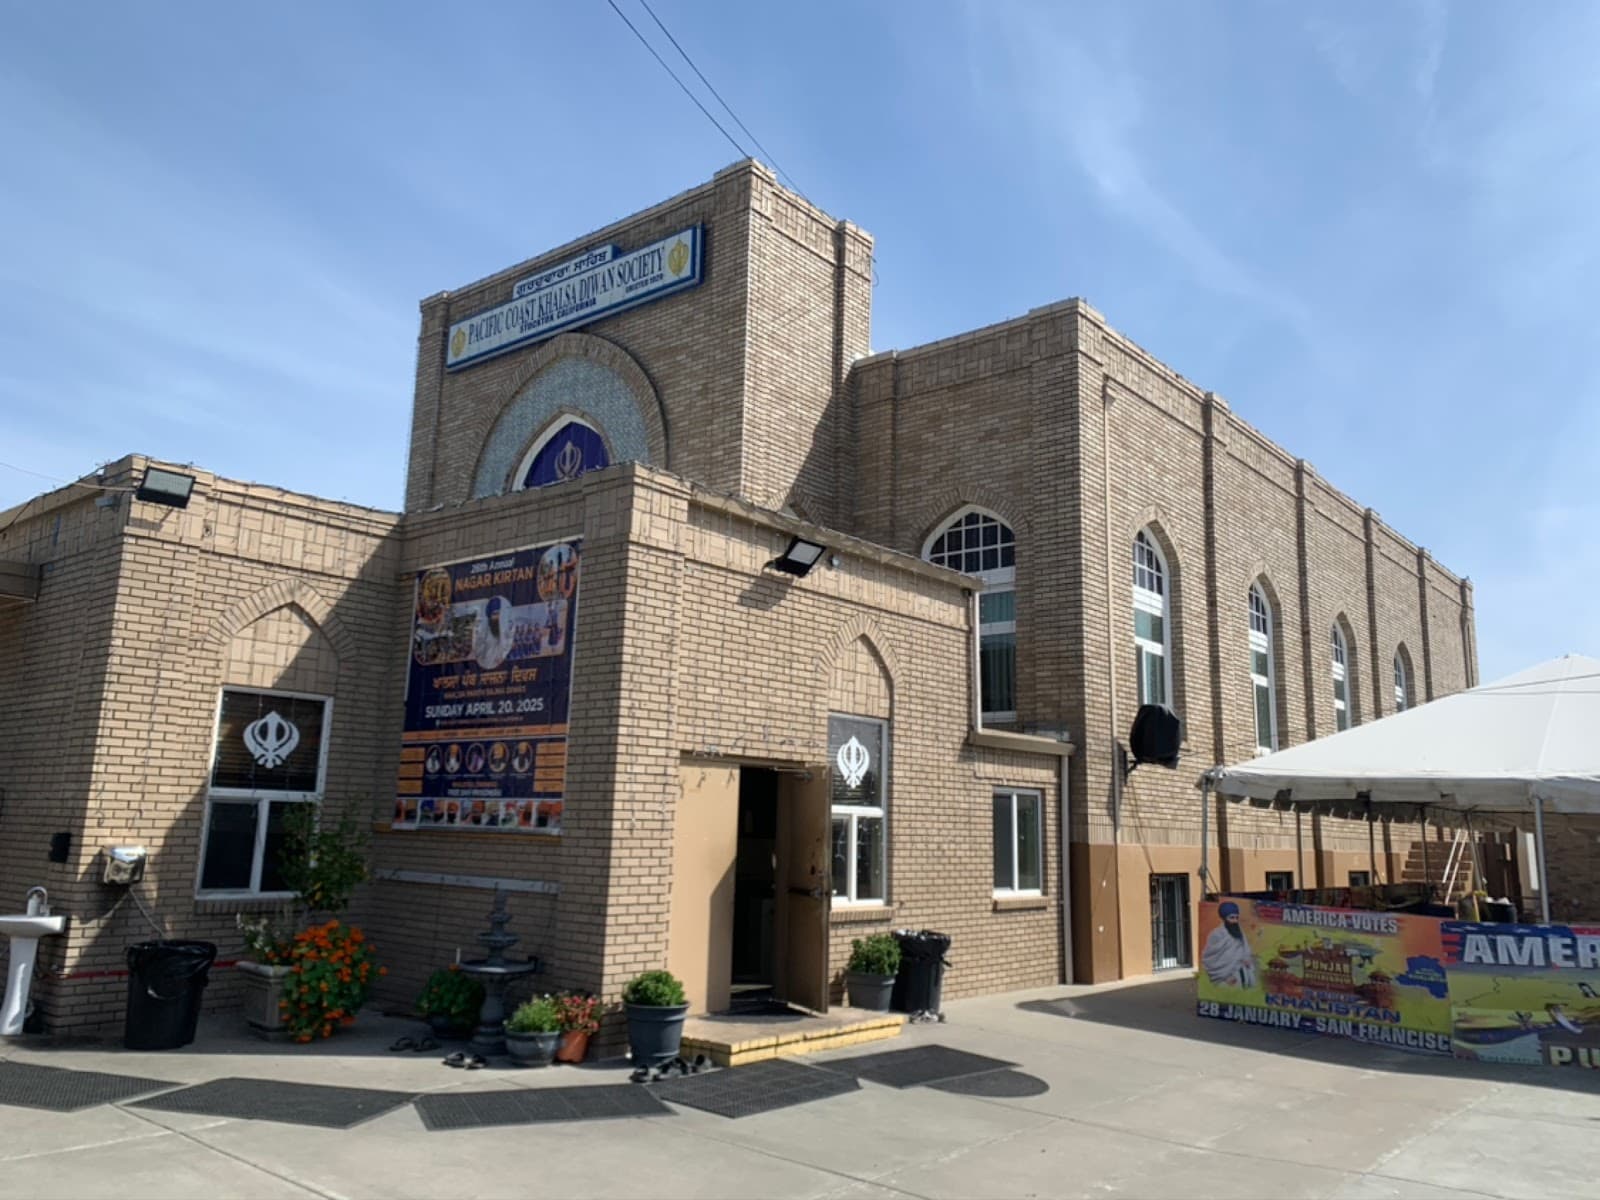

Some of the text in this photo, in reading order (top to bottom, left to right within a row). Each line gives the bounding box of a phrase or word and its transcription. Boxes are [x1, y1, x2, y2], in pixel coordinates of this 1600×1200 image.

[468, 247, 664, 345] PACIFIC COAST KHALSA DIWAN SOCIETY
[520, 297, 597, 333] STOCKTON CALIFORNIA
[455, 566, 535, 592] NAGAR KIRTAN
[425, 703, 464, 718] SUNDAY
[465, 701, 496, 716] APRIL
[516, 697, 545, 713] 2025
[1282, 907, 1398, 933] AMERICA VOTES
[1304, 959, 1351, 974] PUNJAB
[1464, 934, 1600, 969] AMER
[1265, 992, 1401, 1023] KHALISTAN
[1200, 1001, 1219, 1016] 28
[1224, 1003, 1301, 1028] JANUARY
[1316, 1018, 1351, 1036] SAN
[1360, 1023, 1450, 1051] FRANCISC
